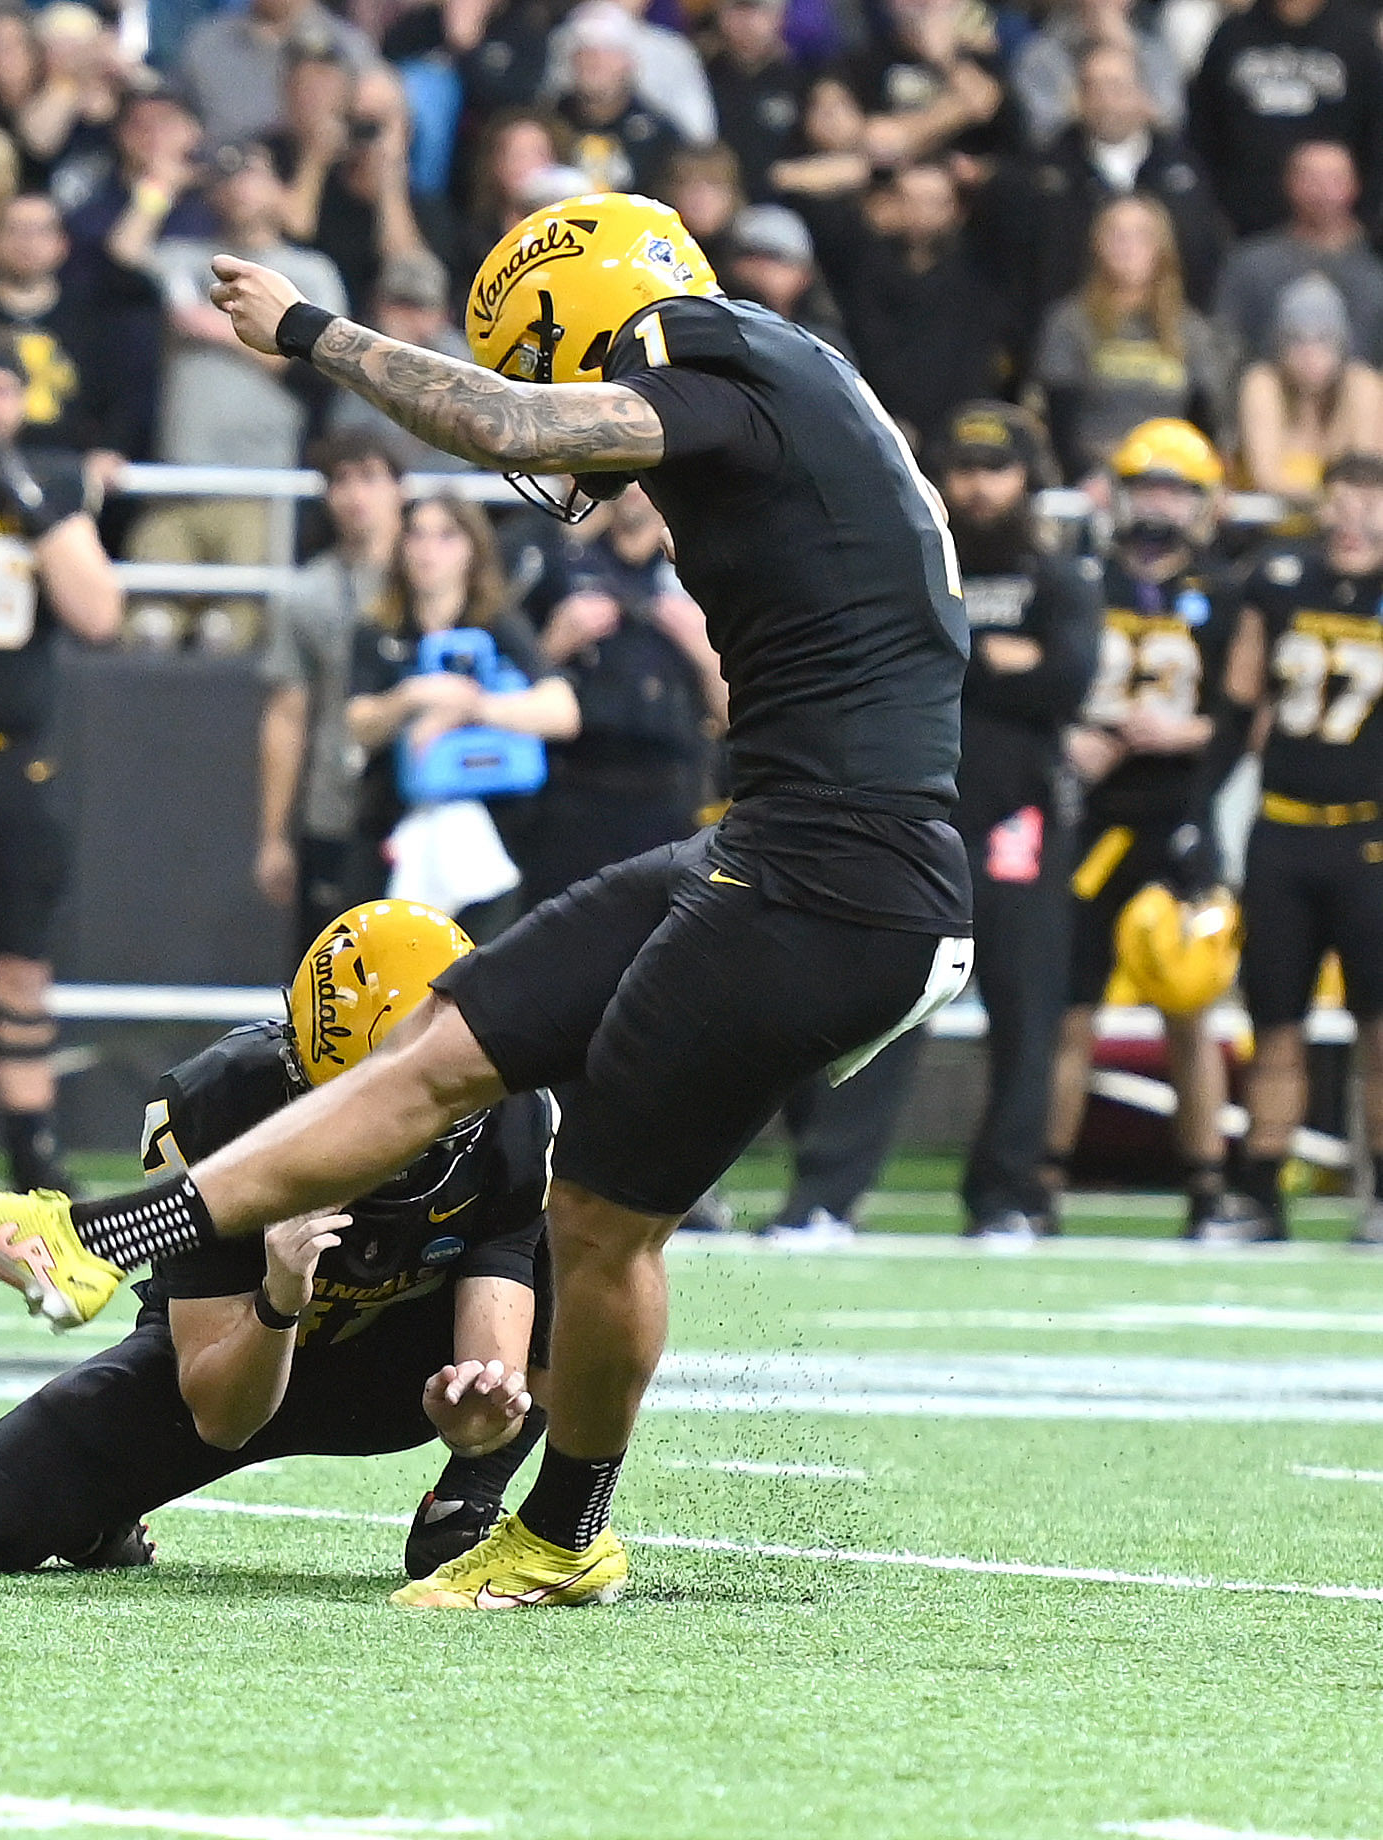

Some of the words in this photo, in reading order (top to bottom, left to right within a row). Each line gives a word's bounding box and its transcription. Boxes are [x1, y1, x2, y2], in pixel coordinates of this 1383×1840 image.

[474, 221, 583, 337] Vandals
[634, 311, 672, 368] 1
[1273, 630, 1383, 744] 37
[309, 930, 356, 1065] Vandals
[312, 1264, 438, 1301] ANDALS
